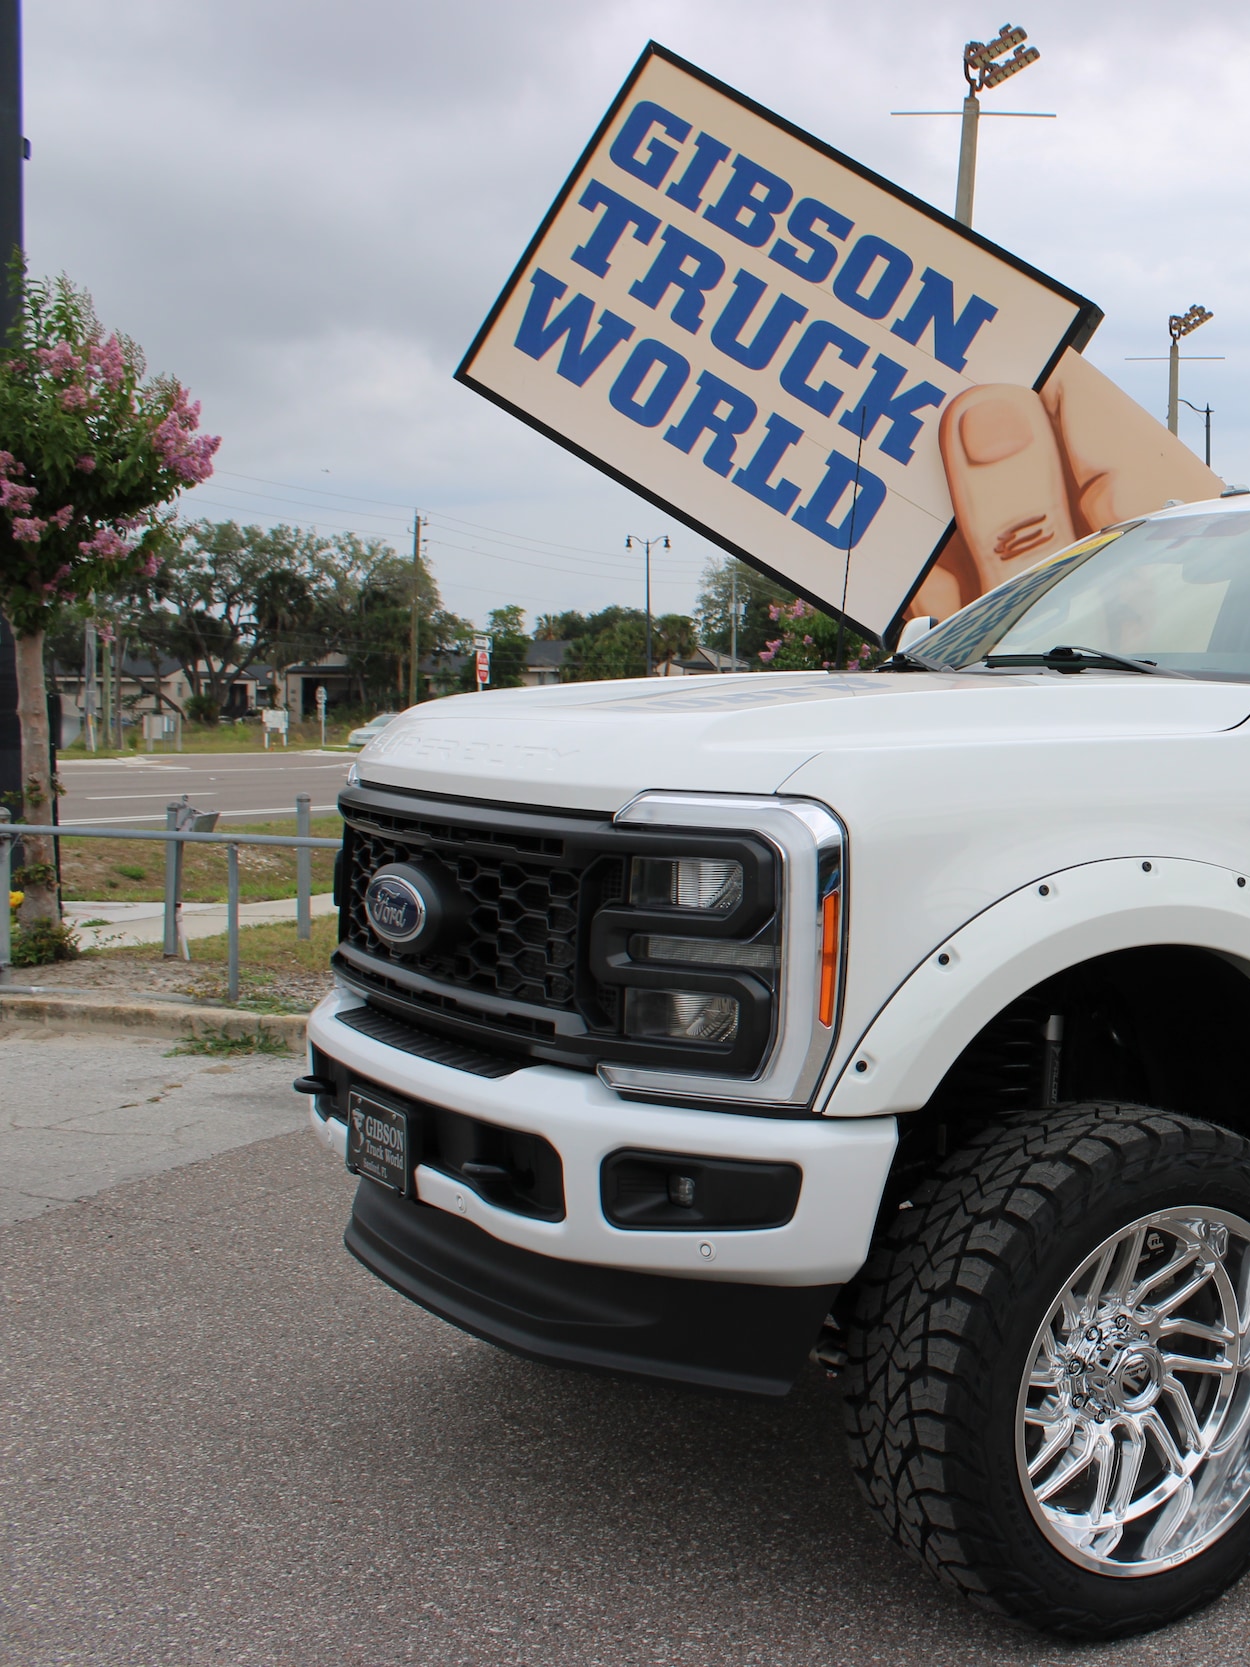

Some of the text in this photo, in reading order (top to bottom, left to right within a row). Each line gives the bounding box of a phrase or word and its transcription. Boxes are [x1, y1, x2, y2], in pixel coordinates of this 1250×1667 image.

[608, 100, 998, 373] GIBSON
[570, 178, 947, 466] TRUCK
[513, 267, 888, 551] WORLD
[374, 887, 408, 928] Ford
[365, 1115, 404, 1153] GIBSON
[366, 1139, 404, 1170] Truck World
